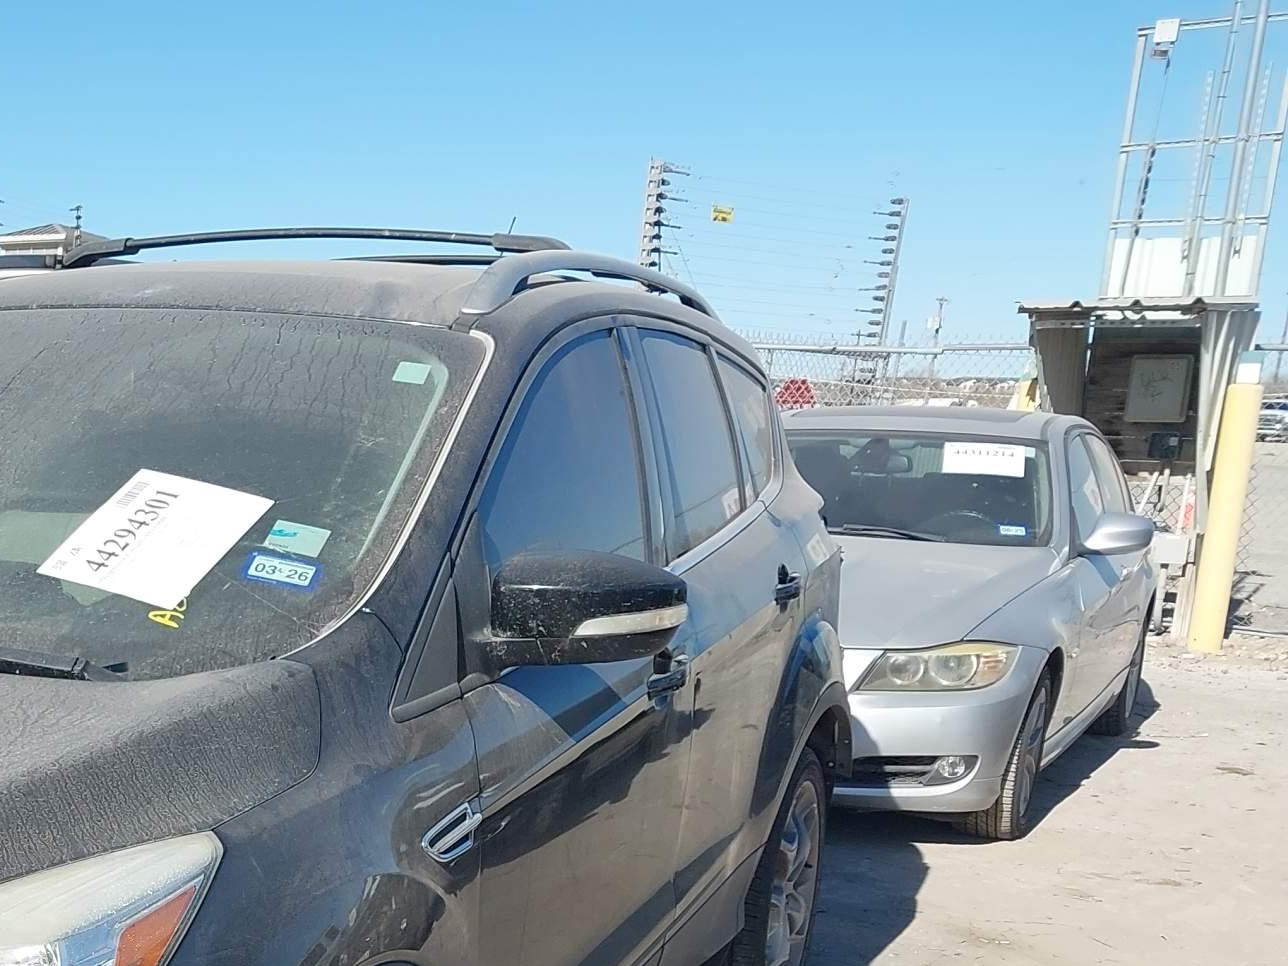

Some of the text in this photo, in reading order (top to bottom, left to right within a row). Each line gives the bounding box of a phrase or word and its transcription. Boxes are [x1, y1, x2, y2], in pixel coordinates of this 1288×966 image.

[86, 490, 180, 572] 44294301
[254, 562, 278, 575] 03
[285, 569, 310, 582] 26
